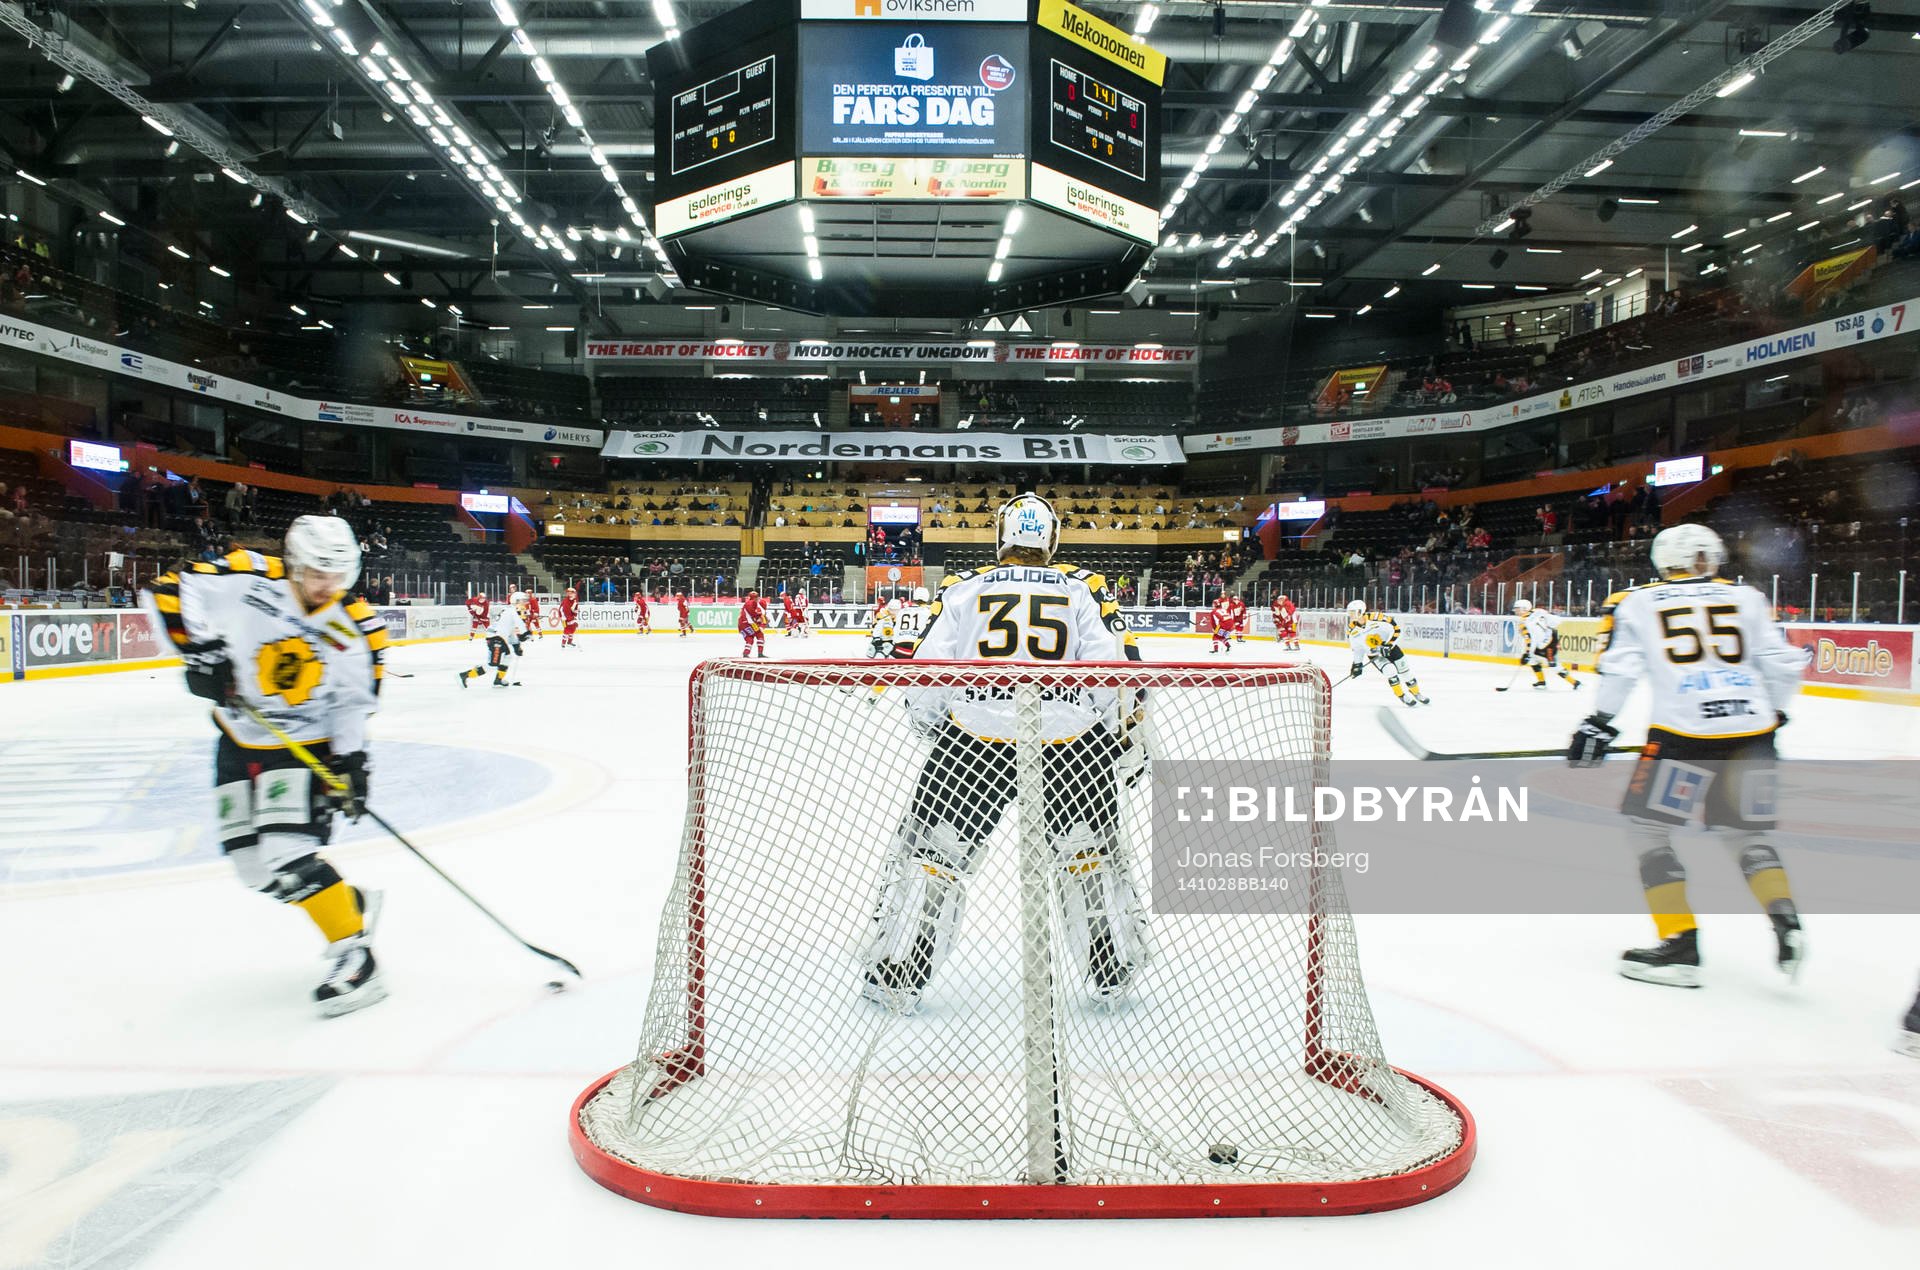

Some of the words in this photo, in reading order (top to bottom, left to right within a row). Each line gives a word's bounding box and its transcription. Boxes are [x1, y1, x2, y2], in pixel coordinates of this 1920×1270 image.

[1061, 10, 1145, 70] Mekonomen
[746, 62, 766, 79] GUEST
[1060, 66, 1077, 83] HOME
[680, 90, 697, 106] HOME
[833, 84, 858, 96] DEN
[858, 84, 910, 96] PERFEKTA
[912, 85, 970, 96] PRESENTEN
[972, 86, 994, 96] TILL
[1068, 83, 1076, 101] 0
[752, 98, 771, 111] PENALTY
[833, 96, 920, 125] FARS
[926, 96, 994, 126] DAG
[1122, 96, 1140, 112] GUEST
[1130, 113, 1137, 129] 0
[712, 136, 718, 149] 0
[729, 130, 736, 143] 0
[1092, 137, 1098, 149] 0
[1108, 143, 1113, 156] 0
[689, 184, 751, 219] isolerings
[1067, 182, 1124, 216] isolerings
[1836, 320, 1850, 332] TSS
[1852, 315, 1864, 329] AB
[1892, 304, 1905, 332] 7
[588, 344, 618, 356] THE
[620, 344, 673, 356] HEART
[678, 345, 700, 357] OF
[702, 345, 769, 358] HOCKEY
[794, 346, 844, 358] MODO
[846, 346, 914, 359] HOCKEY
[916, 346, 989, 359] UNGDOM
[1746, 331, 1816, 362] HOLMEN
[1016, 348, 1046, 360] THE
[1048, 348, 1103, 360] HEART
[1106, 348, 1126, 360] OF
[1130, 349, 1195, 362] HOCKEY
[1613, 372, 1666, 392] Handelsbanken
[878, 387, 920, 395] REJLERS
[394, 414, 411, 424] ICA
[414, 416, 456, 427] Supermarket
[558, 432, 591, 442] IMERYS
[701, 434, 1002, 458] Nordemans
[1023, 436, 1088, 459] Bil
[983, 569, 1068, 586] BOLIDEN
[697, 610, 732, 626] OCAY!
[900, 614, 919, 630] 61
[1124, 614, 1154, 628] R.SE
[978, 594, 1069, 660] 35
[1414, 626, 1444, 640] NYBERGS
[1658, 604, 1744, 664] 55
[1817, 638, 1894, 677] Dumle
